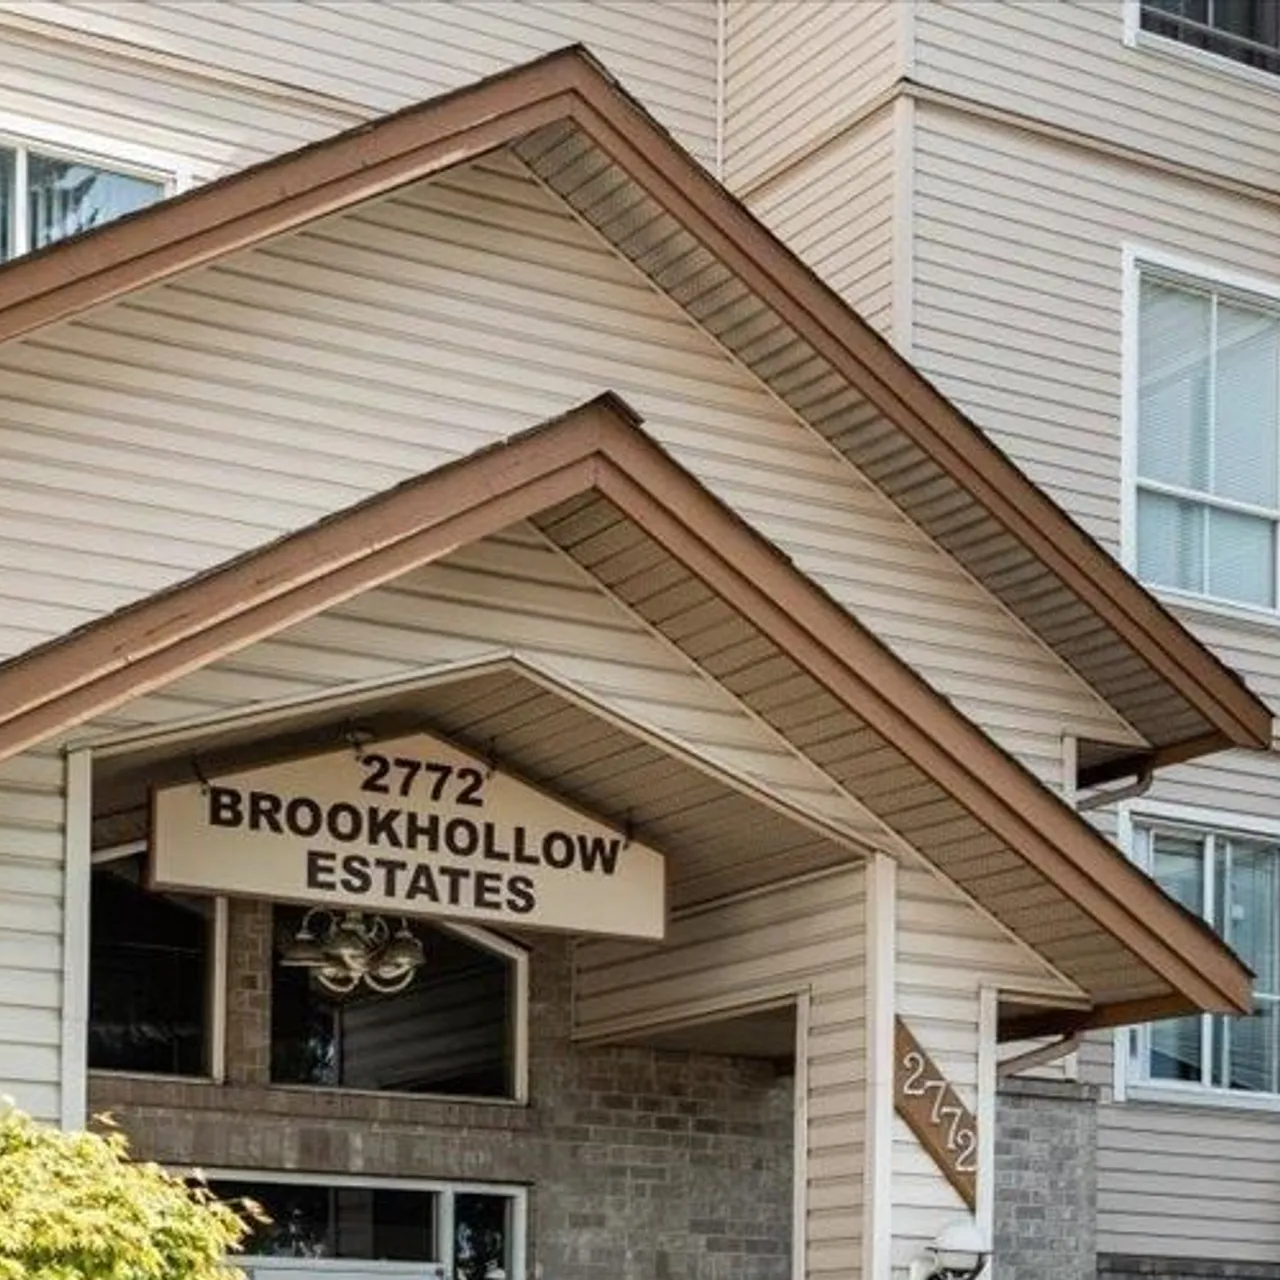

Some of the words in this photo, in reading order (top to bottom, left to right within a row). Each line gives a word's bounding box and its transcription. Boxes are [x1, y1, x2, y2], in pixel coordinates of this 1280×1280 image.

[360, 754, 485, 807] 2772
[208, 787, 620, 875] BROOKHOLLOW
[306, 850, 537, 914] ESTATES
[903, 1052, 979, 1172] 2772
